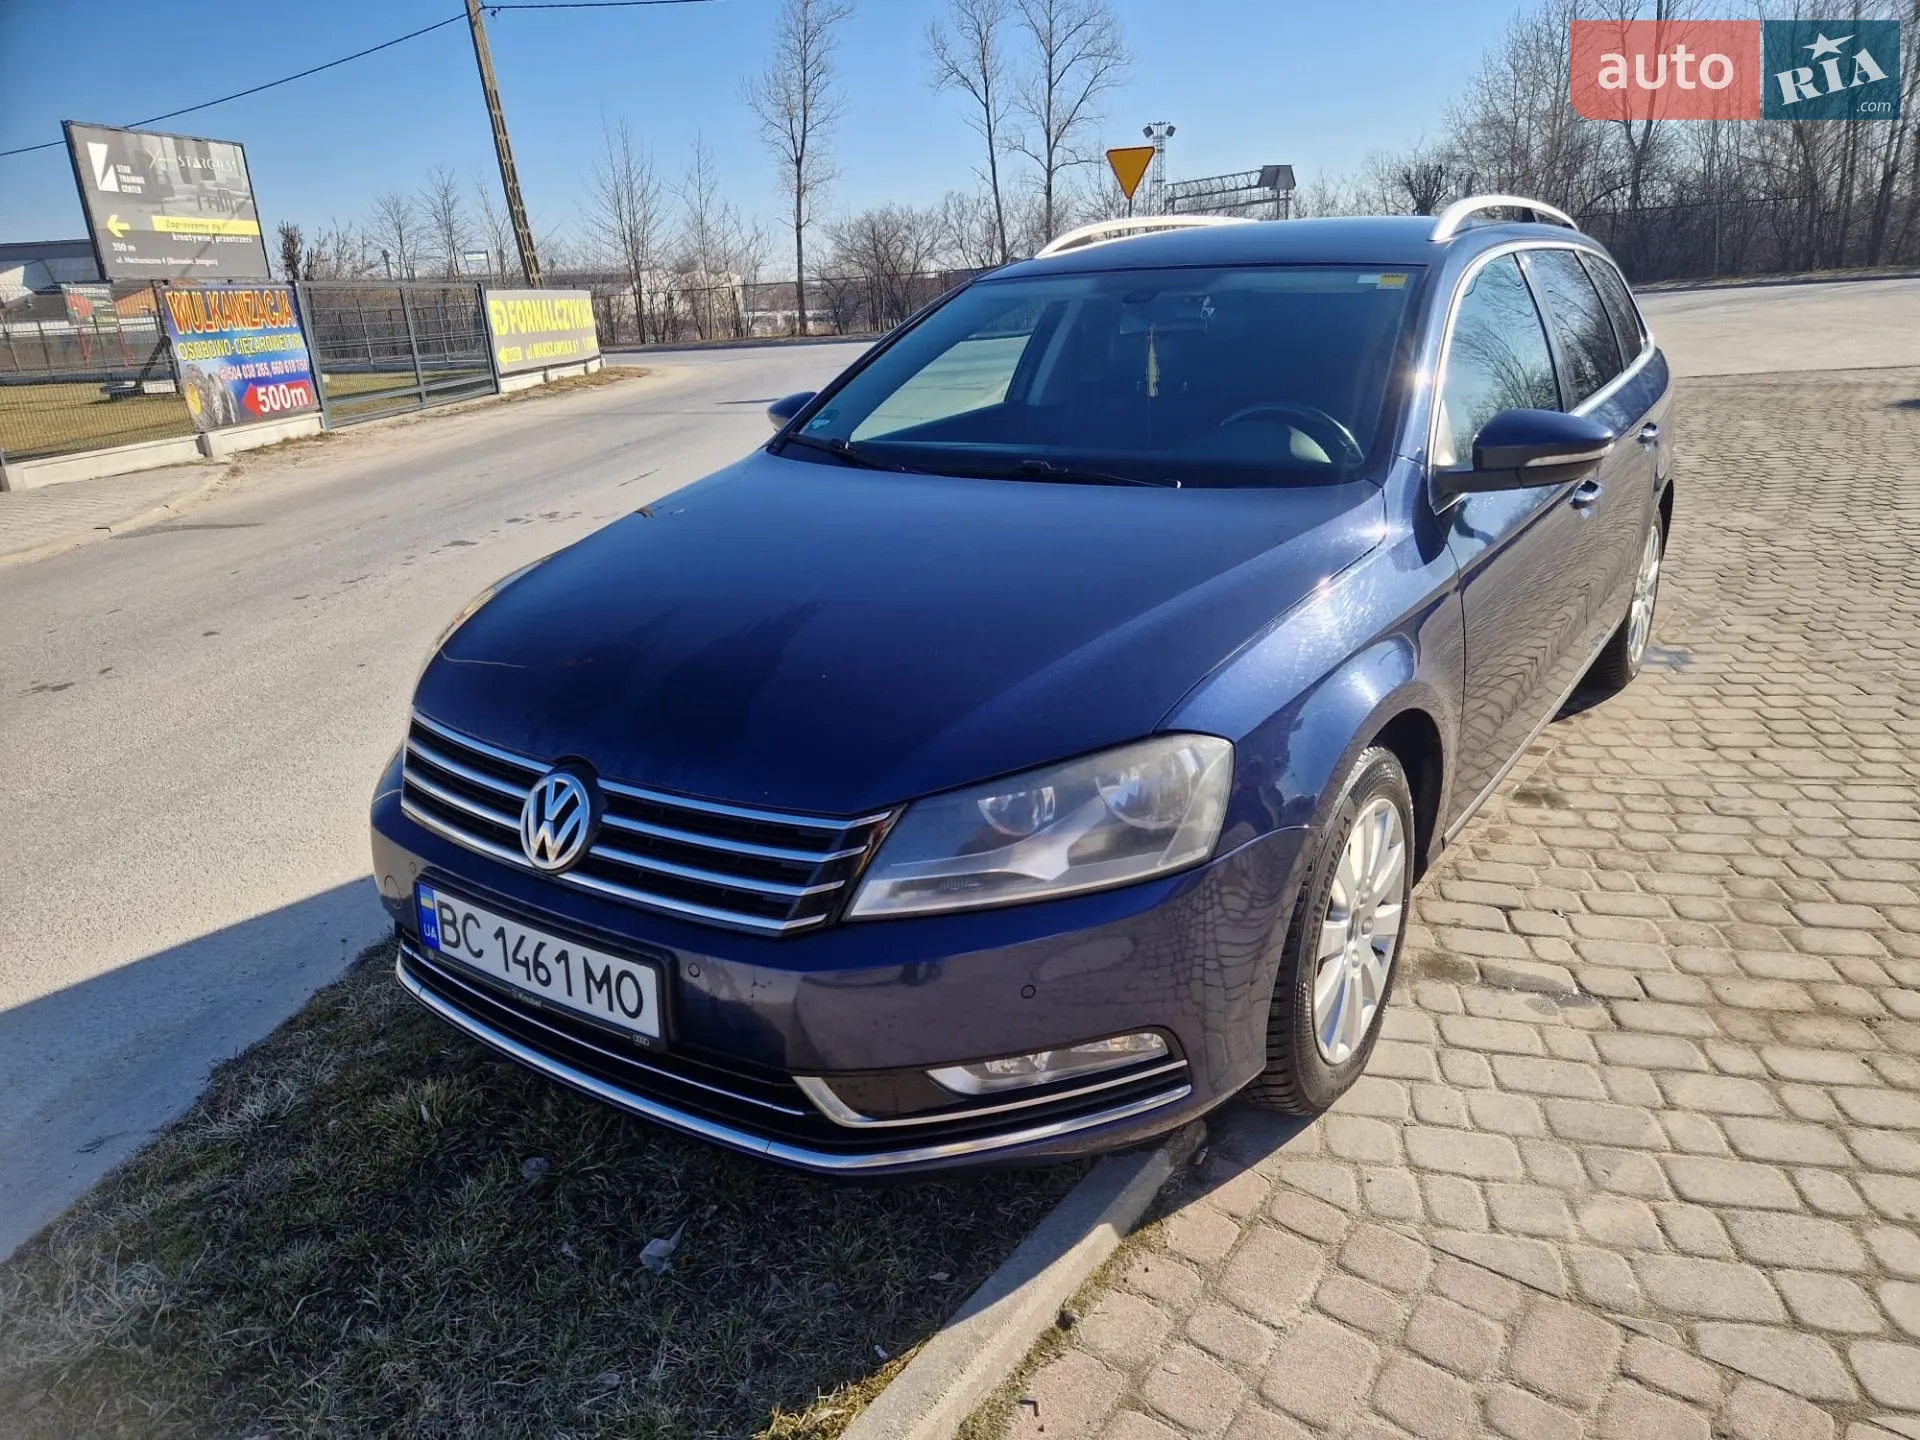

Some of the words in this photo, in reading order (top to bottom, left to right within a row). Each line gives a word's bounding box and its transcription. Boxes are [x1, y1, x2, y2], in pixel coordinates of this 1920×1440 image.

[166, 290, 296, 334] WULKANIZACJA
[256, 384, 309, 413] 500m
[423, 924, 438, 941] UA
[437, 900, 483, 959] BC
[493, 926, 573, 997] 1461
[583, 956, 644, 1019] MO
